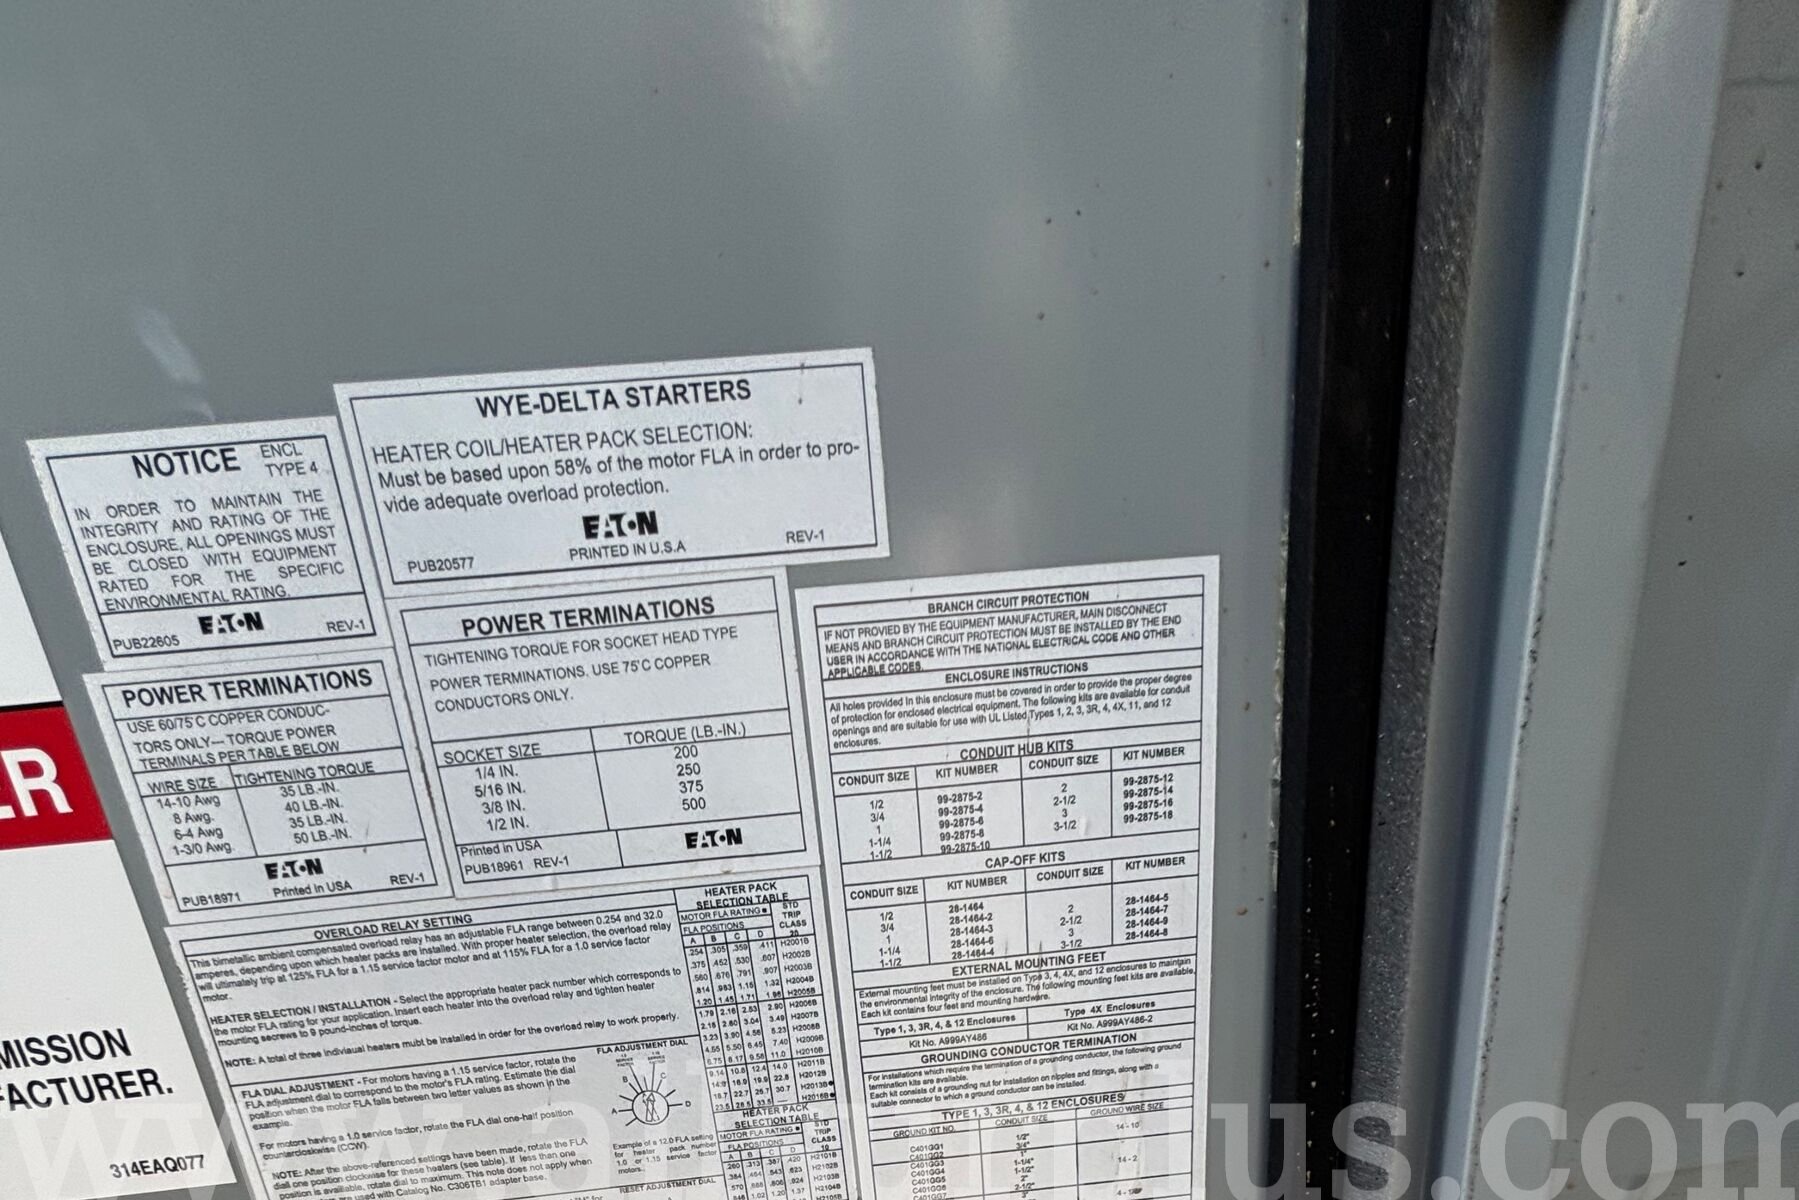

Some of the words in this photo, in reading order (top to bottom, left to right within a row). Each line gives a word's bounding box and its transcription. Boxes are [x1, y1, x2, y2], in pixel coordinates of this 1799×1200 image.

[475, 388, 619, 417] WYE-DELTA
[624, 378, 751, 408] STARTERS
[259, 442, 302, 458] ENCL
[370, 442, 451, 464] HEATER
[455, 433, 582, 458] COIL/HEATER
[585, 428, 638, 449] PACK
[642, 421, 752, 445] SELECTION:
[131, 447, 241, 478] NOTICE
[264, 461, 306, 477] TYPE
[309, 460, 318, 473] 4
[377, 470, 421, 488] Must
[423, 468, 446, 485] be
[450, 463, 502, 483] based
[507, 464, 549, 482] upon
[554, 457, 591, 476] 58%
[596, 455, 612, 473] of
[616, 454, 643, 471] the
[647, 451, 695, 469] motor
[700, 447, 735, 465] FLA
[738, 446, 753, 462] in
[758, 442, 801, 461] order
[805, 441, 821, 457] to
[826, 441, 859, 460] pro-
[73, 507, 90, 520] IN
[105, 501, 160, 518] ORDER
[173, 498, 196, 512] TO
[210, 491, 282, 510] MAINTAIN
[291, 488, 324, 503] THE
[383, 495, 419, 513] vide
[423, 489, 502, 511] adequate
[507, 482, 578, 504] overload
[583, 477, 668, 503] protection.
[79, 520, 158, 538] INTEGRITY
[172, 516, 202, 532] AND
[208, 511, 265, 528] RATING
[272, 509, 292, 524] OF
[298, 506, 331, 521] THE
[85, 537, 183, 557] ENCLOSURE,
[186, 535, 213, 549] ALL
[214, 528, 292, 547] OPENINGS
[294, 524, 335, 541] MUST
[785, 528, 824, 543] REV-1
[91, 561, 114, 575] BE
[128, 555, 188, 572] CLOSED
[202, 551, 241, 566] WITH
[251, 542, 336, 563] EQUIPMENT
[568, 543, 629, 560] PRINTED
[632, 542, 646, 556] IN
[649, 539, 686, 554] U.S.A
[407, 556, 474, 573] PUB20577
[97, 577, 148, 593] RATED
[170, 573, 204, 587] FOR
[224, 568, 256, 583] THE
[277, 561, 344, 579] SPECIFIC
[103, 590, 229, 612] ENVIRONMENTAL
[231, 584, 290, 601] RATING.
[927, 599, 973, 615] BRANCH
[976, 595, 1020, 612] CIRCUIT
[1020, 590, 1090, 608] PROTECTION
[325, 618, 365, 632] REV-1
[461, 612, 545, 637] POWER
[548, 596, 714, 628] TERMINATIONS
[113, 635, 180, 651] PUB22605
[423, 647, 508, 667] TIGHTENING
[510, 641, 569, 658] TORQUE
[571, 638, 601, 653] FOR
[603, 632, 658, 650] SOCKET
[662, 629, 699, 644] HEAD
[701, 625, 738, 640] TYPE
[429, 674, 482, 691] POWER
[483, 664, 588, 686] TERMINATIONS.
[591, 661, 619, 676] USE
[653, 653, 711, 670] COPPER
[944, 668, 1009, 683] ENCLOSURE
[1012, 661, 1088, 678] INSTRUCTIONS
[121, 683, 206, 708] POWER
[207, 668, 372, 700] TERMINATIONS
[623, 726, 687, 748] TORQUE
[692, 723, 746, 741] (LB.-IN.)
[443, 746, 503, 764] SOCKET
[507, 742, 544, 759] SIZE
[672, 743, 698, 759] 200
[959, 743, 1014, 760] CONDUIT
[1017, 741, 1043, 755] HUB
[1046, 738, 1074, 753] KITS
[1123, 749, 1139, 760] KIT
[1141, 746, 1184, 759] NUMBER
[234, 768, 316, 786] TIGHTENING
[317, 760, 375, 778] TORQUE
[676, 762, 700, 776] 250
[1123, 772, 1173, 786] 99-2875-12
[0, 748, 74, 820] R
[147, 779, 184, 794] WIRE
[186, 776, 219, 791] SIZE
[678, 779, 703, 793] 375
[681, 796, 706, 811] 500
[464, 858, 524, 876] PUB18961
[533, 855, 568, 868] REV-1
[984, 853, 1036, 868] CAP-OFF
[1038, 850, 1065, 863] KITS
[389, 871, 424, 885] REV-1
[704, 884, 746, 897] HEATER
[748, 881, 777, 892] PACK
[182, 892, 241, 906] PUB18971
[313, 923, 379, 940] OVERLOAD
[382, 922, 420, 934] RELAY
[422, 913, 473, 930] SETTING
[951, 960, 1012, 976] EXTERNAL
[1014, 953, 1074, 970] MOUNTING
[1077, 950, 1106, 963] FEET
[920, 1048, 987, 1063] GROUNDING
[990, 1040, 1060, 1056] CONDUCTOR
[1062, 1032, 1136, 1048] TERMINATION
[0, 1068, 173, 1110] ACTURER.
[109, 1154, 203, 1178] 314EAQ077
